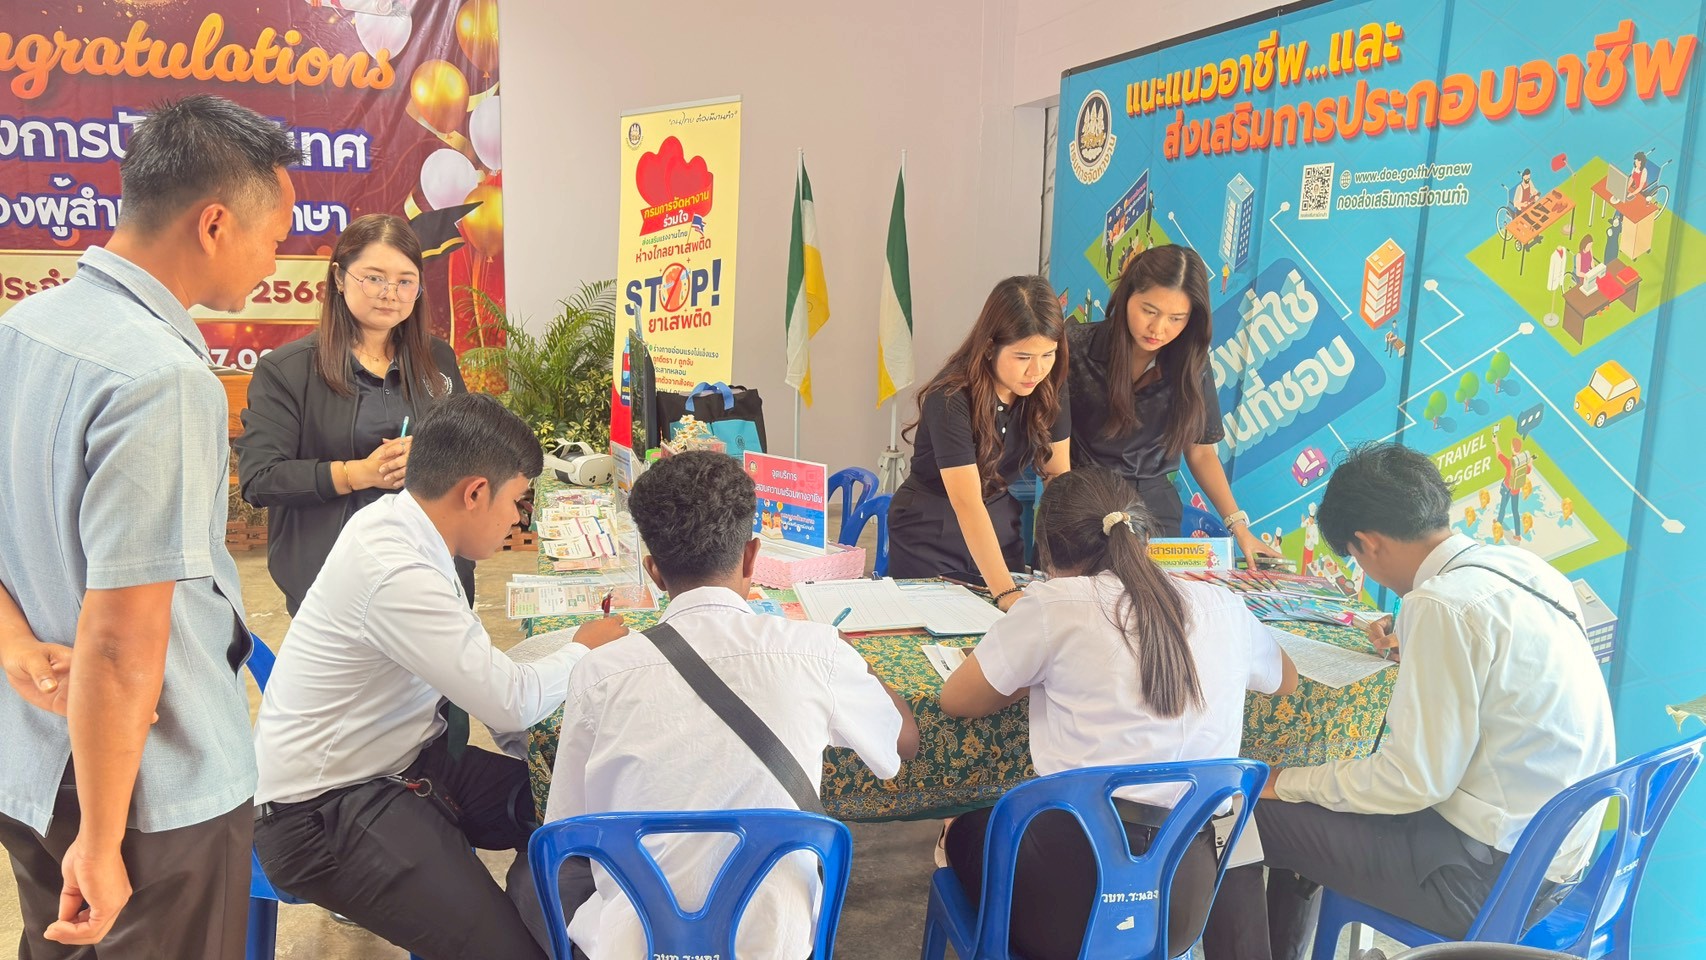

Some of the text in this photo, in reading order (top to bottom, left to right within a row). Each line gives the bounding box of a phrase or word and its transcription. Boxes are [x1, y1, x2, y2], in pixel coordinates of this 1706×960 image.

[1163, 19, 1698, 159] ส่งเสริมการประกอบอาชีพ
[1355, 163, 1472, 184] www.doe.go.th/vgnew
[643, 190, 711, 220] กรมการจัดหางาน
[1337, 184, 1469, 210] กองส่งเสริมการมีงานทำ
[663, 209, 689, 228] ร่วมใจ
[635, 236, 712, 264] ห่างไกลยาเสพติด
[648, 308, 712, 334] ยาเสพติด
[1437, 434, 1487, 470] TRAVEL
[771, 469, 798, 481] จุดบริการ
